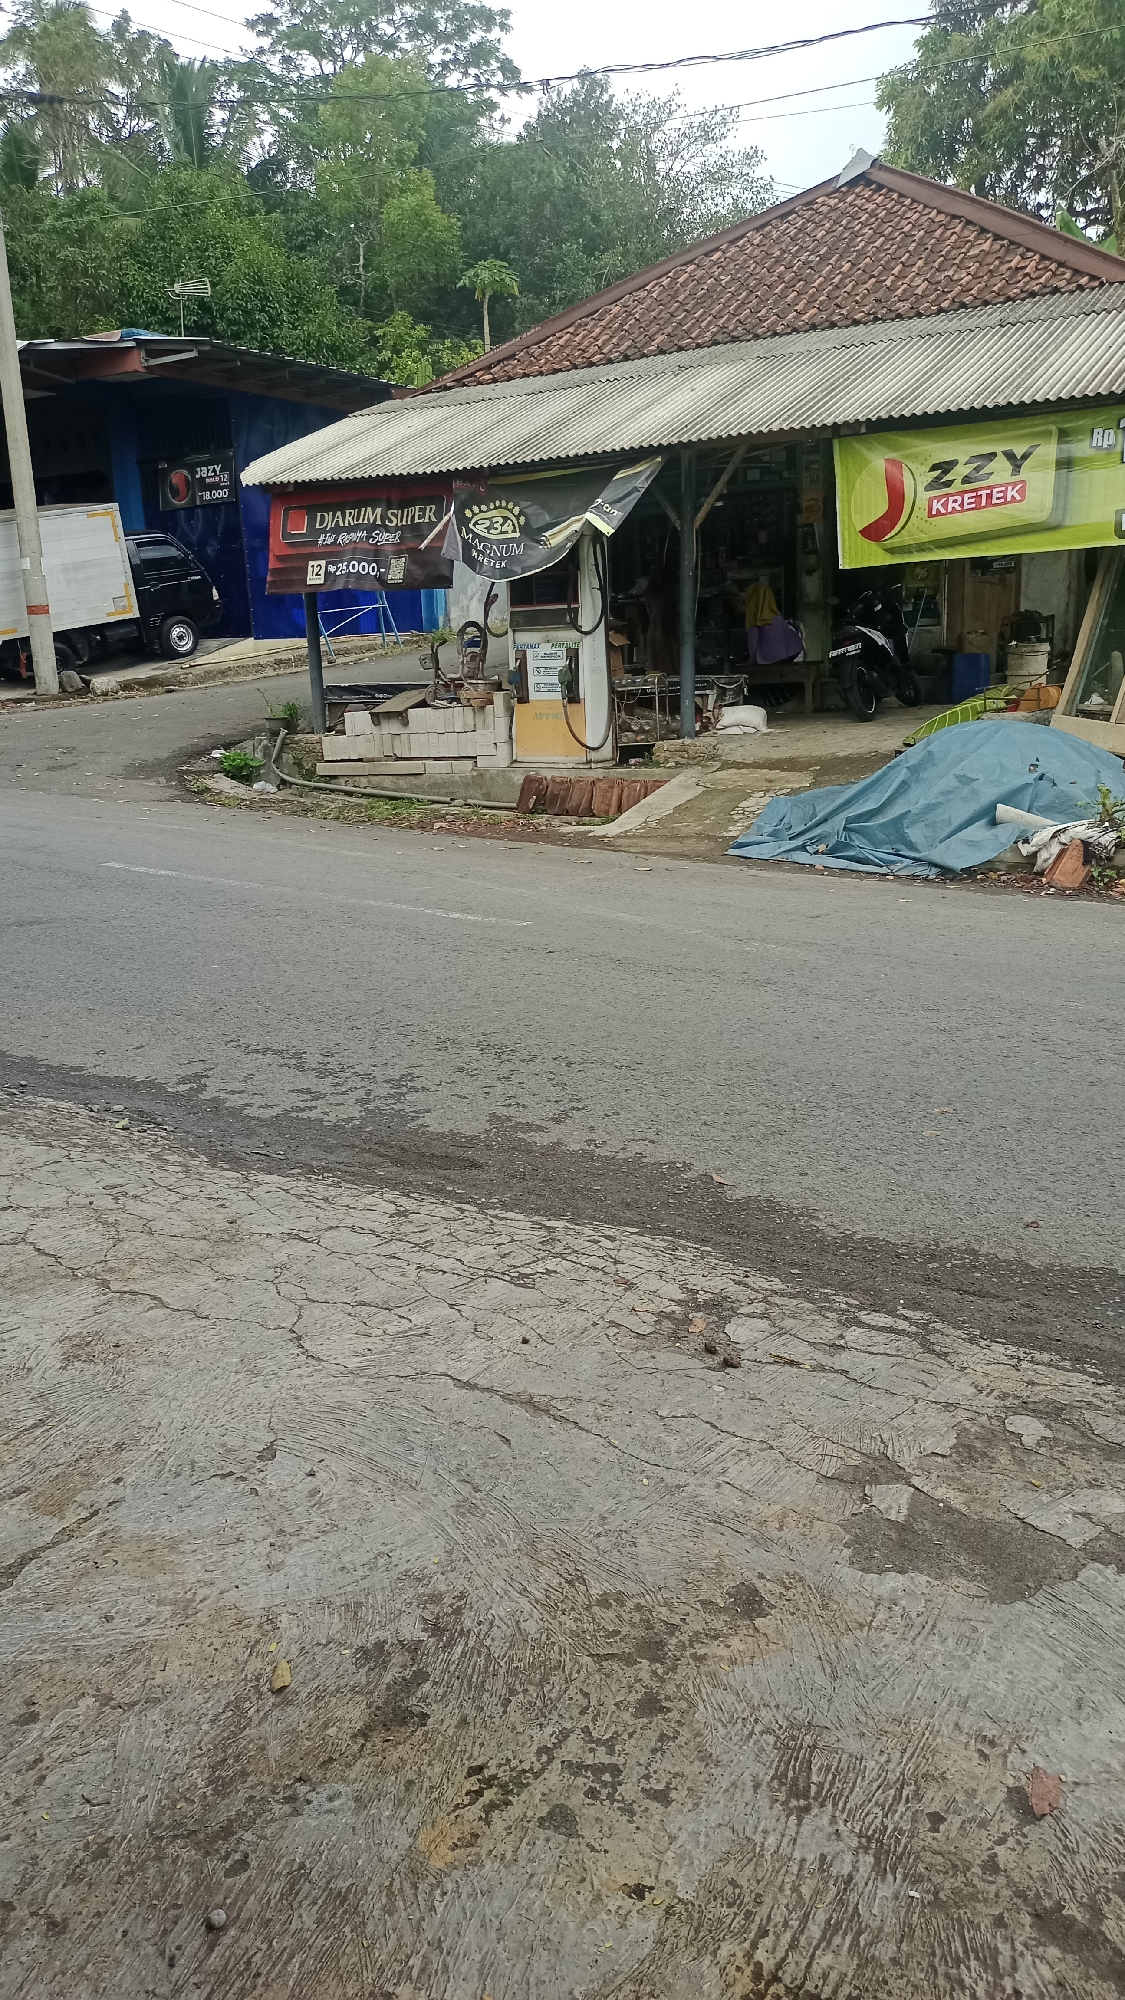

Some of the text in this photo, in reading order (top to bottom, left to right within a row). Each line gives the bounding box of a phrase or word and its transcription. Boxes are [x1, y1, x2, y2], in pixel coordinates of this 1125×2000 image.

[1091, 428, 1115, 448] Rp
[220, 474, 228, 482] 12
[456, 478, 486, 492] BARU
[931, 483, 1024, 515] KRETEK
[316, 504, 438, 530] DJARUM SUPER
[475, 517, 514, 534] 234
[368, 530, 402, 546] SUPER
[460, 526, 526, 557] MAGNUM
[472, 548, 508, 569] KRETEK
[310, 563, 323, 577] 12
[551, 641, 581, 649] PERTALITE
